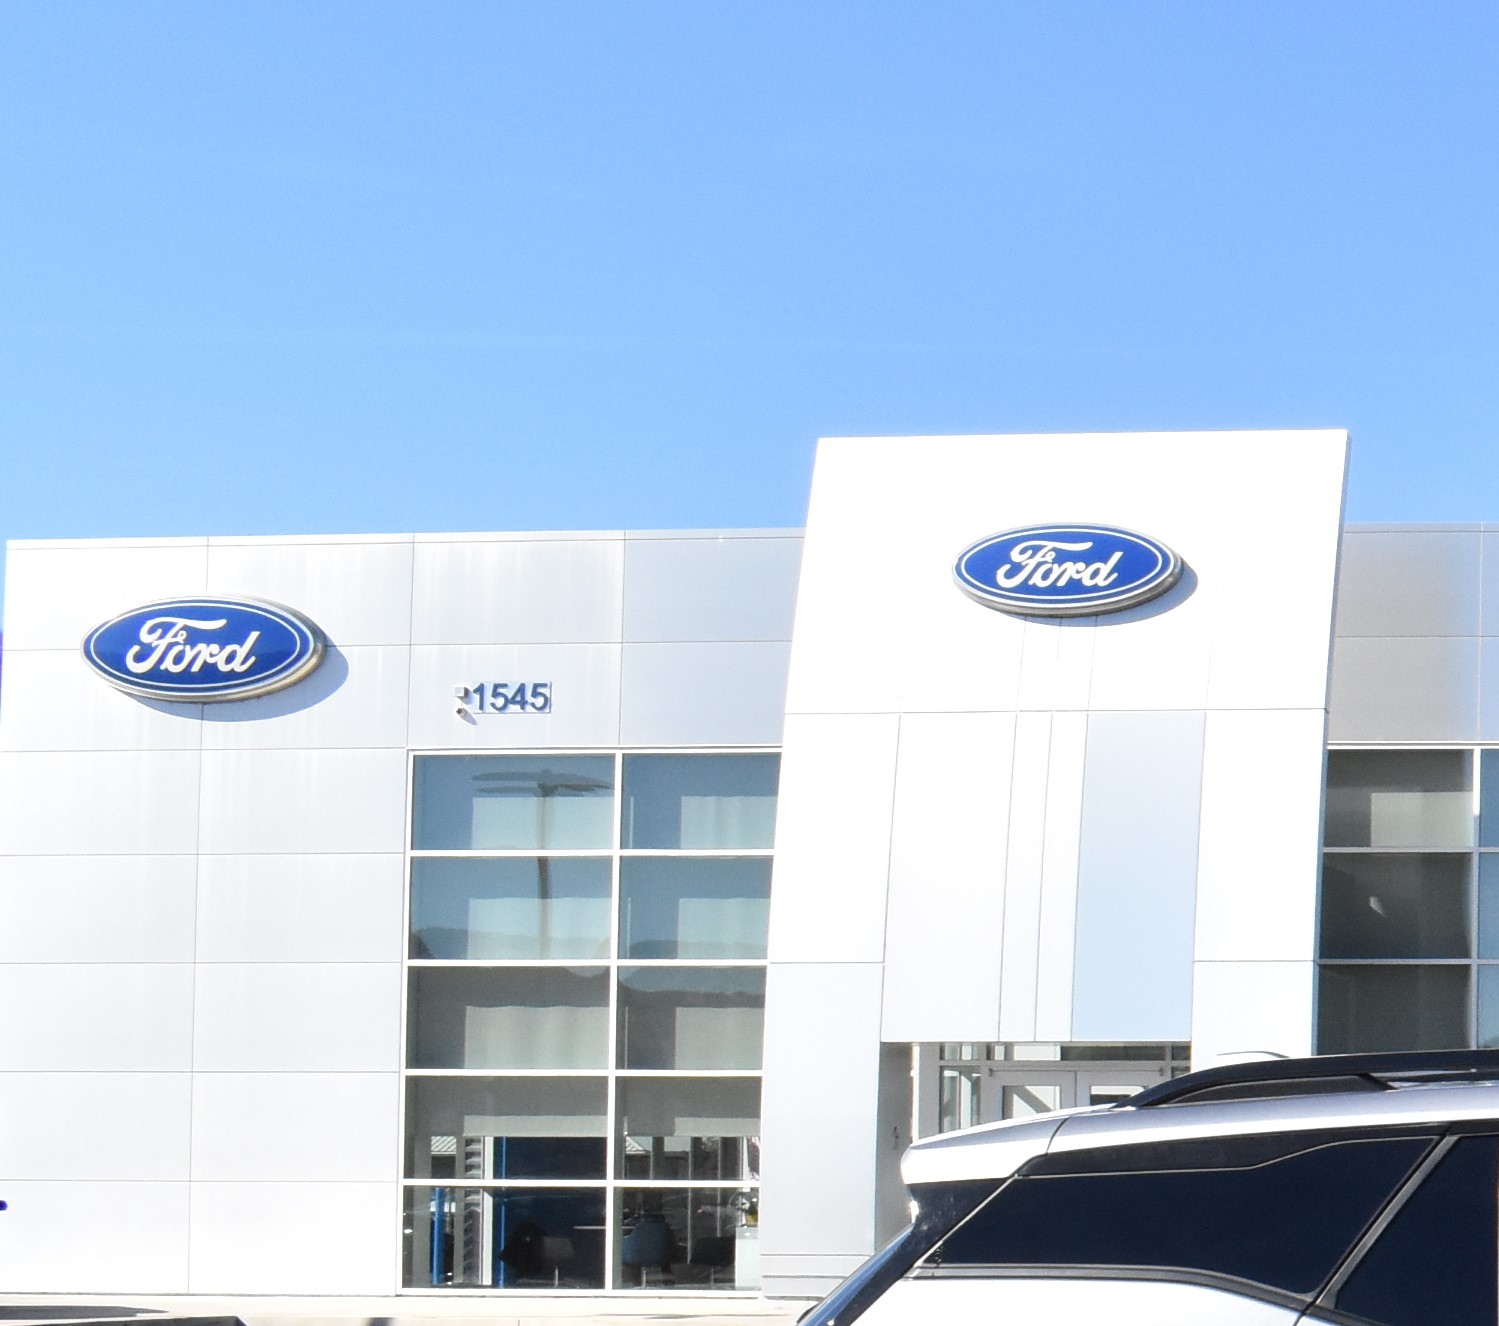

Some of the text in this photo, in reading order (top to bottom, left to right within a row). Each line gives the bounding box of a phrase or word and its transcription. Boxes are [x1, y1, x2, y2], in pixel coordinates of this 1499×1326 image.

[995, 540, 1124, 588] Ford
[125, 616, 261, 673] Ford
[472, 682, 549, 712] 1545
